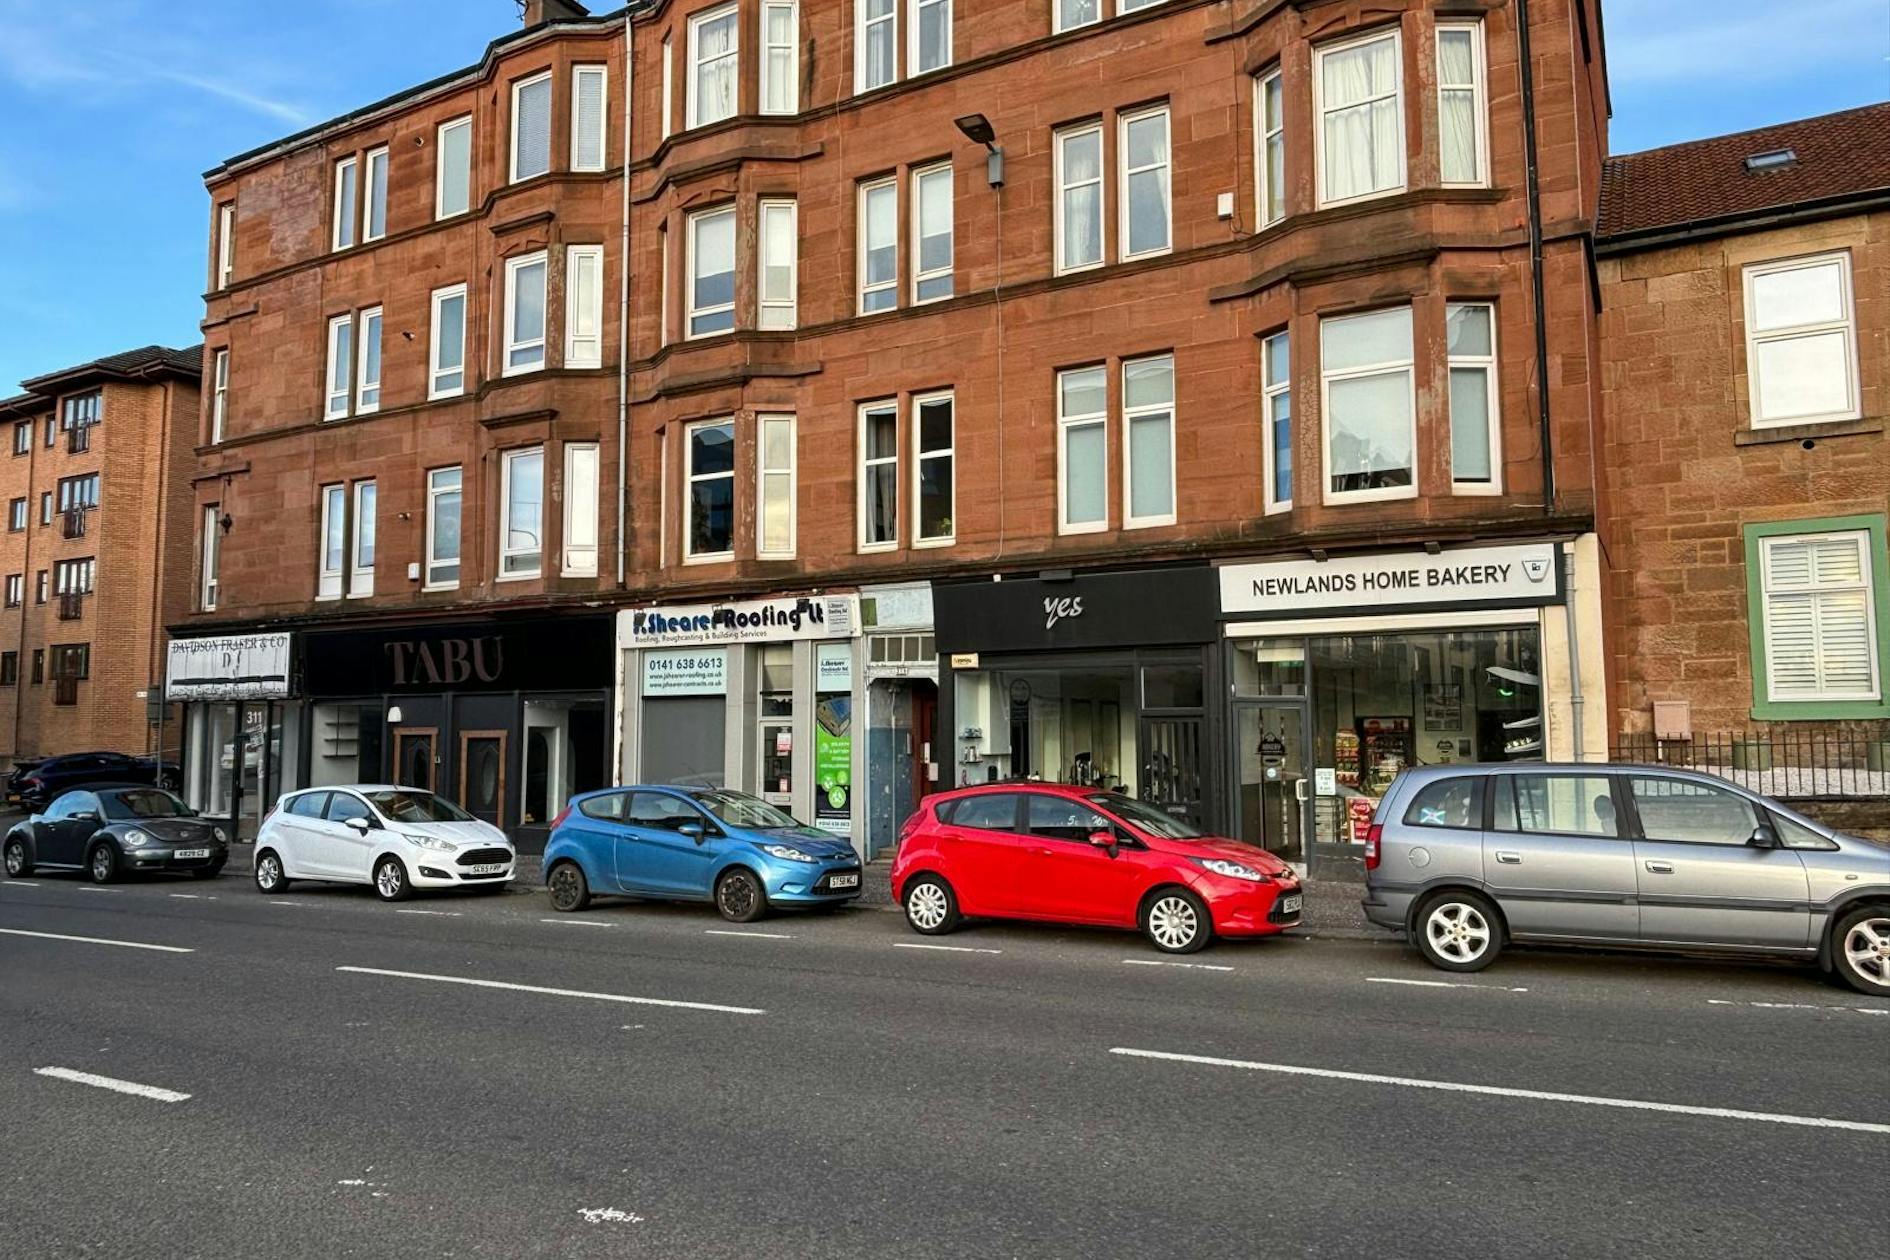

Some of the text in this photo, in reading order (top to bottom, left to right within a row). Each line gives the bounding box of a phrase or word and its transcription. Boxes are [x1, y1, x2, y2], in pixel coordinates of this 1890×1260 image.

[1252, 564, 1511, 596] NEWLANDS HOME BAKERY
[722, 605, 801, 632] Roofing
[1043, 596, 1082, 630] yes
[269, 635, 287, 648] CO
[712, 631, 739, 639] Building
[384, 636, 504, 684] TABU
[649, 657, 722, 670] 0141 638 6613
[247, 711, 262, 724] 311
